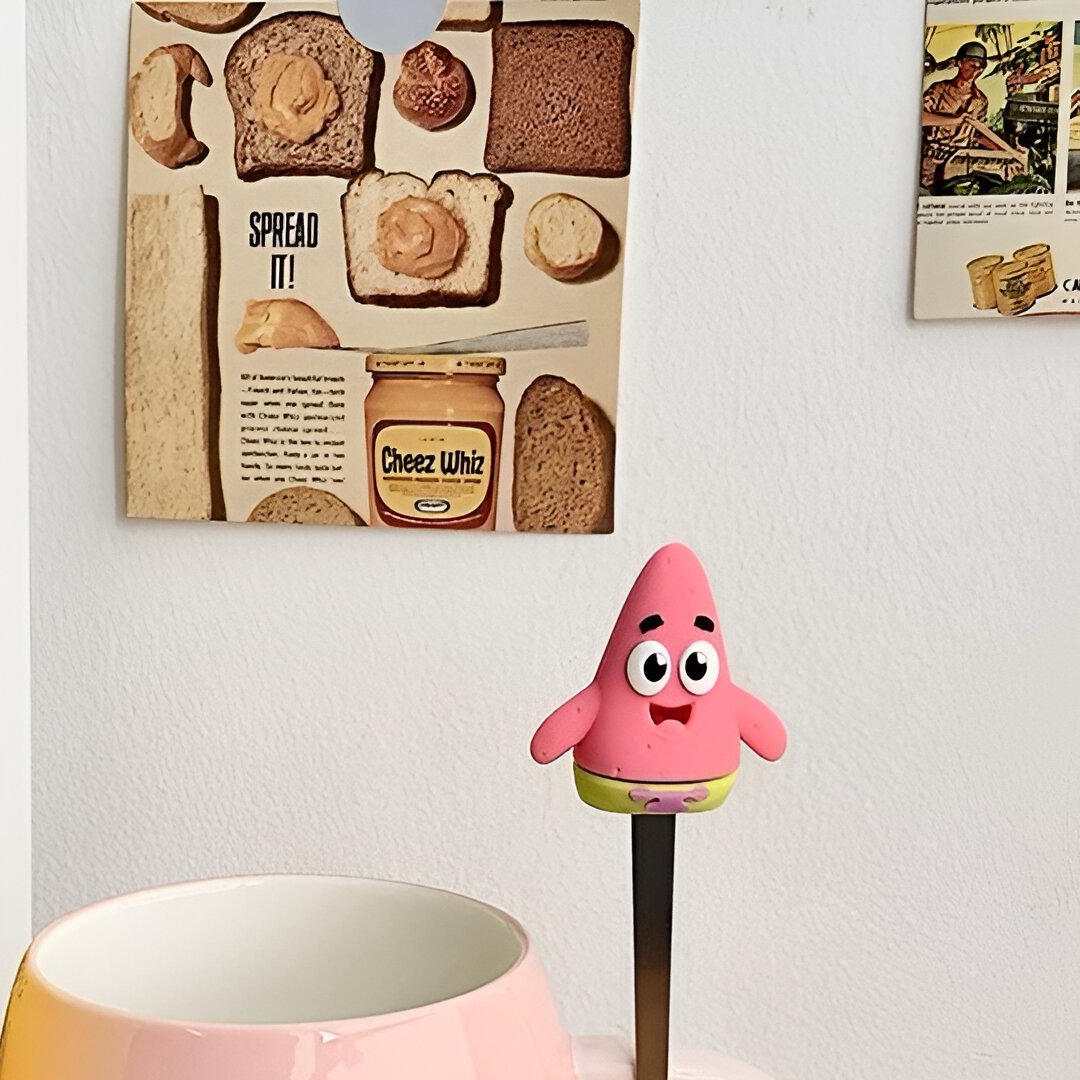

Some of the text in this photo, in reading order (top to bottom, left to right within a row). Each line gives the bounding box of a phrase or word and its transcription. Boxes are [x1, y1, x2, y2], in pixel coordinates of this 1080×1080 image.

[249, 211, 319, 248] SPREAD
[271, 254, 295, 289] IT!
[381, 446, 485, 476] Cheez Whiz
